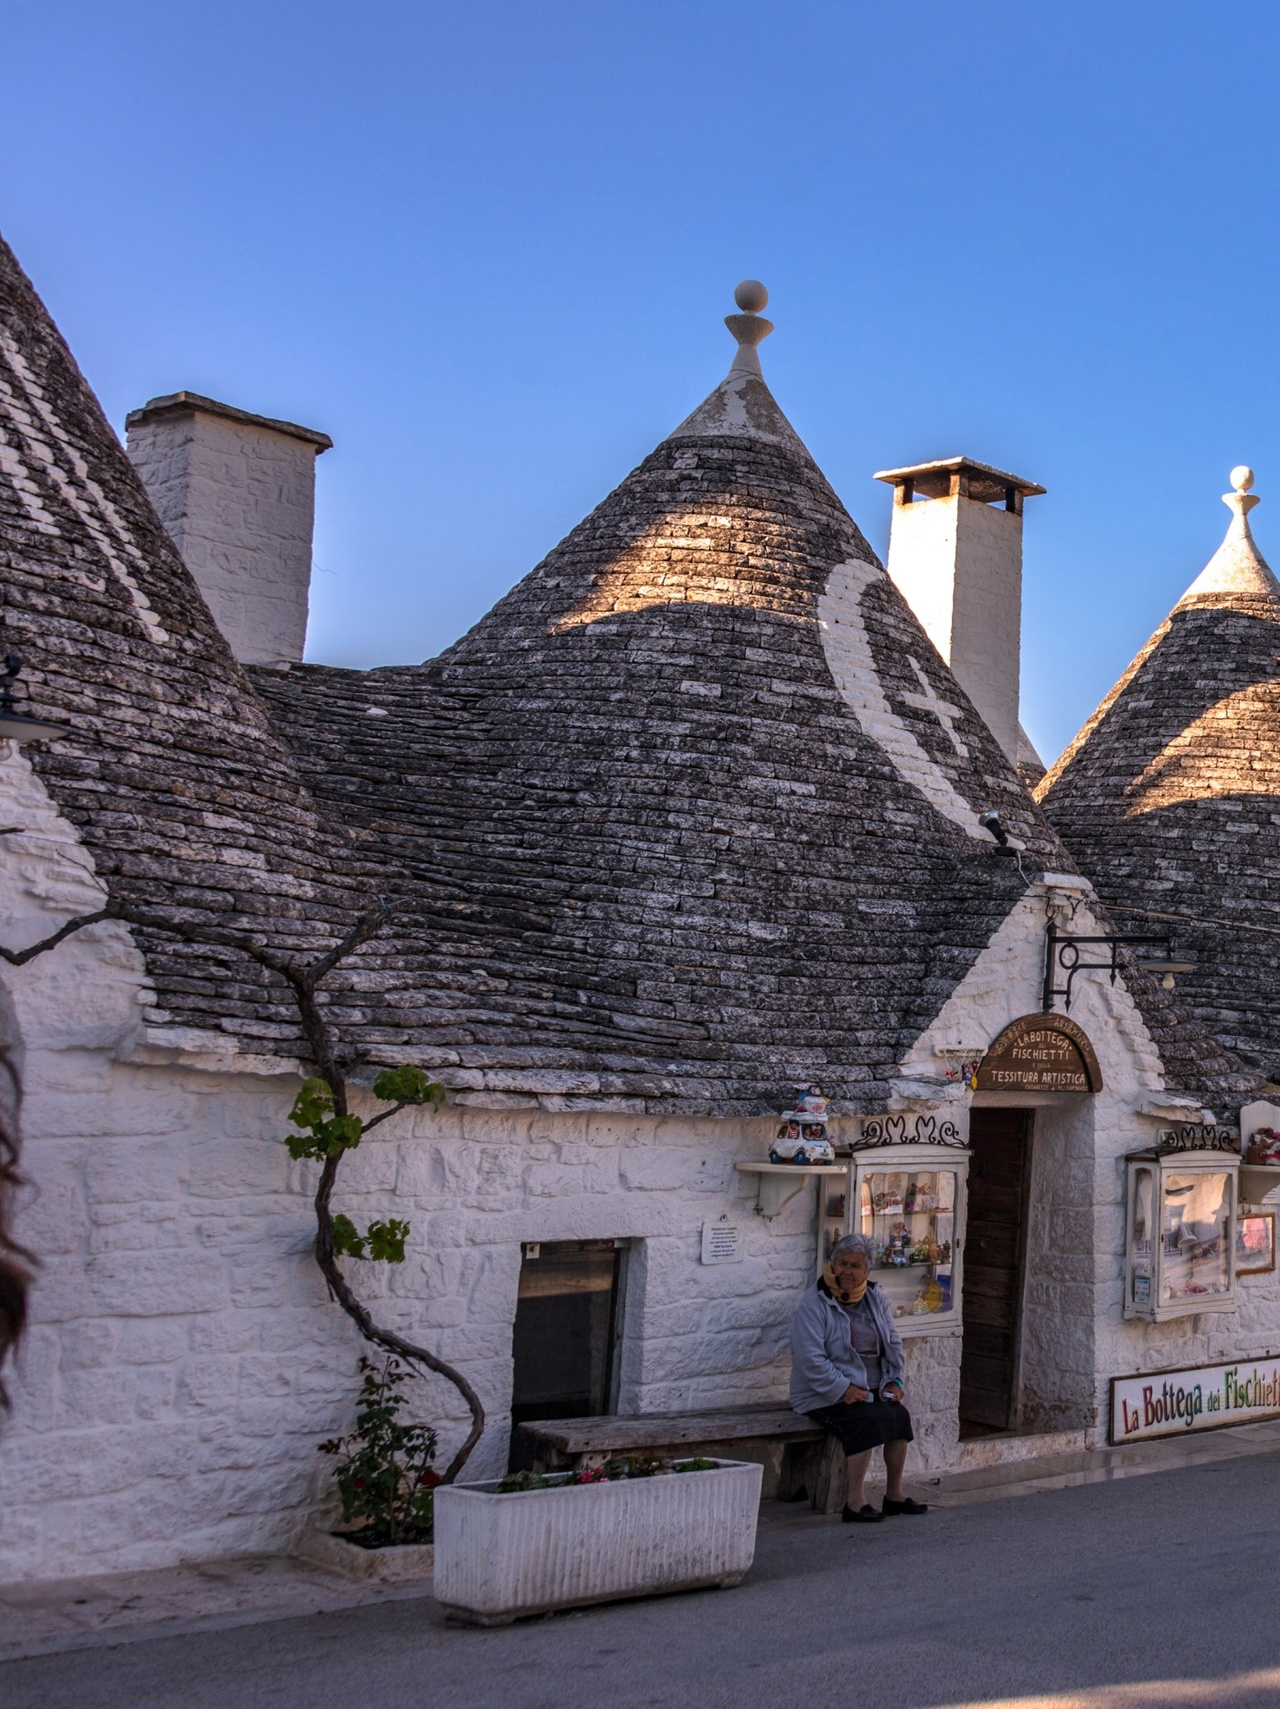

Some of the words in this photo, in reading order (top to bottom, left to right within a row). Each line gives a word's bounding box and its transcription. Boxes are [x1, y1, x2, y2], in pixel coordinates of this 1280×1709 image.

[1012, 1048, 1069, 1060] FISCHIETTI
[991, 1070, 1039, 1083] TESSITURA
[1041, 1072, 1086, 1084] ARTISTICA
[1121, 1398, 1139, 1434] La
[1142, 1380, 1203, 1427] Bottega
[1207, 1388, 1220, 1412] dei
